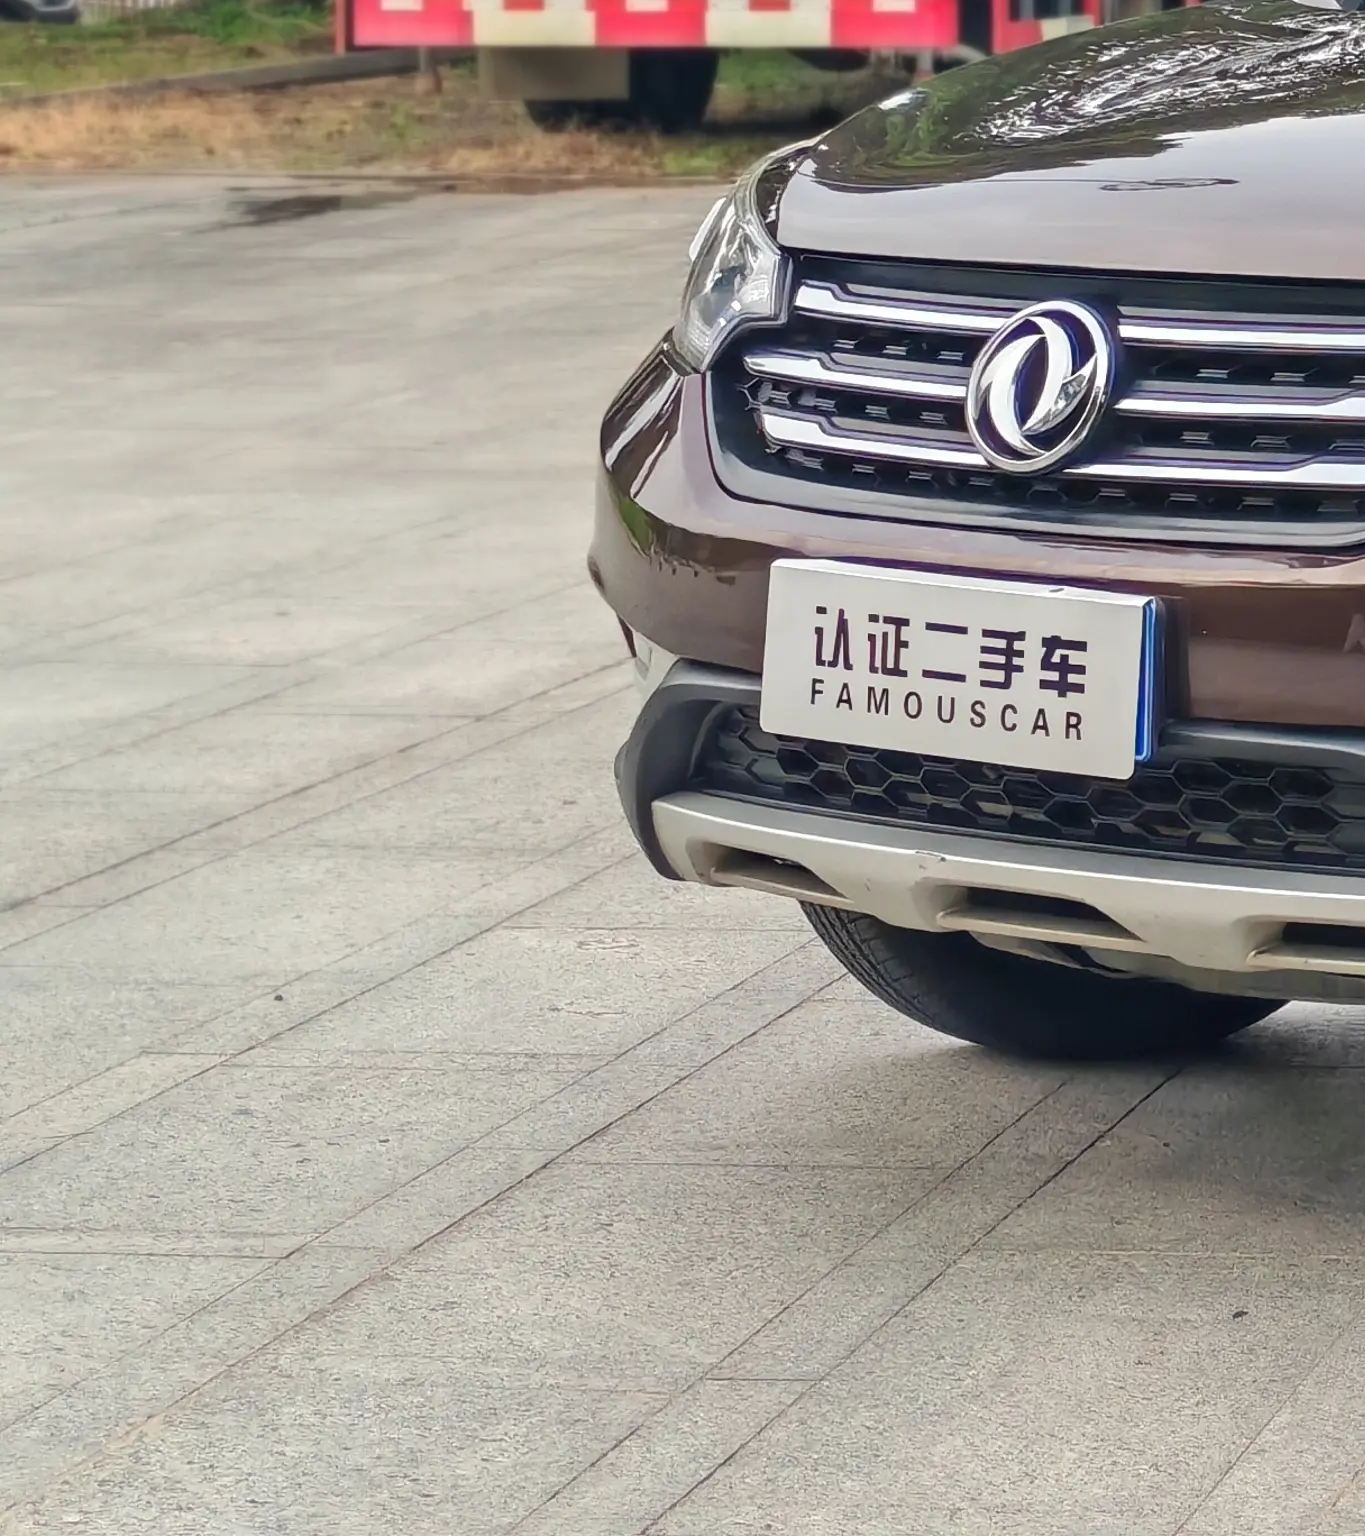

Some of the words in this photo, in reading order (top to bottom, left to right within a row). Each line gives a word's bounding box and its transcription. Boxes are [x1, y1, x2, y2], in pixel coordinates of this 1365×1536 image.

[814, 605, 1088, 698] 认证二手车
[810, 677, 1083, 741] FAMOUSCAR
